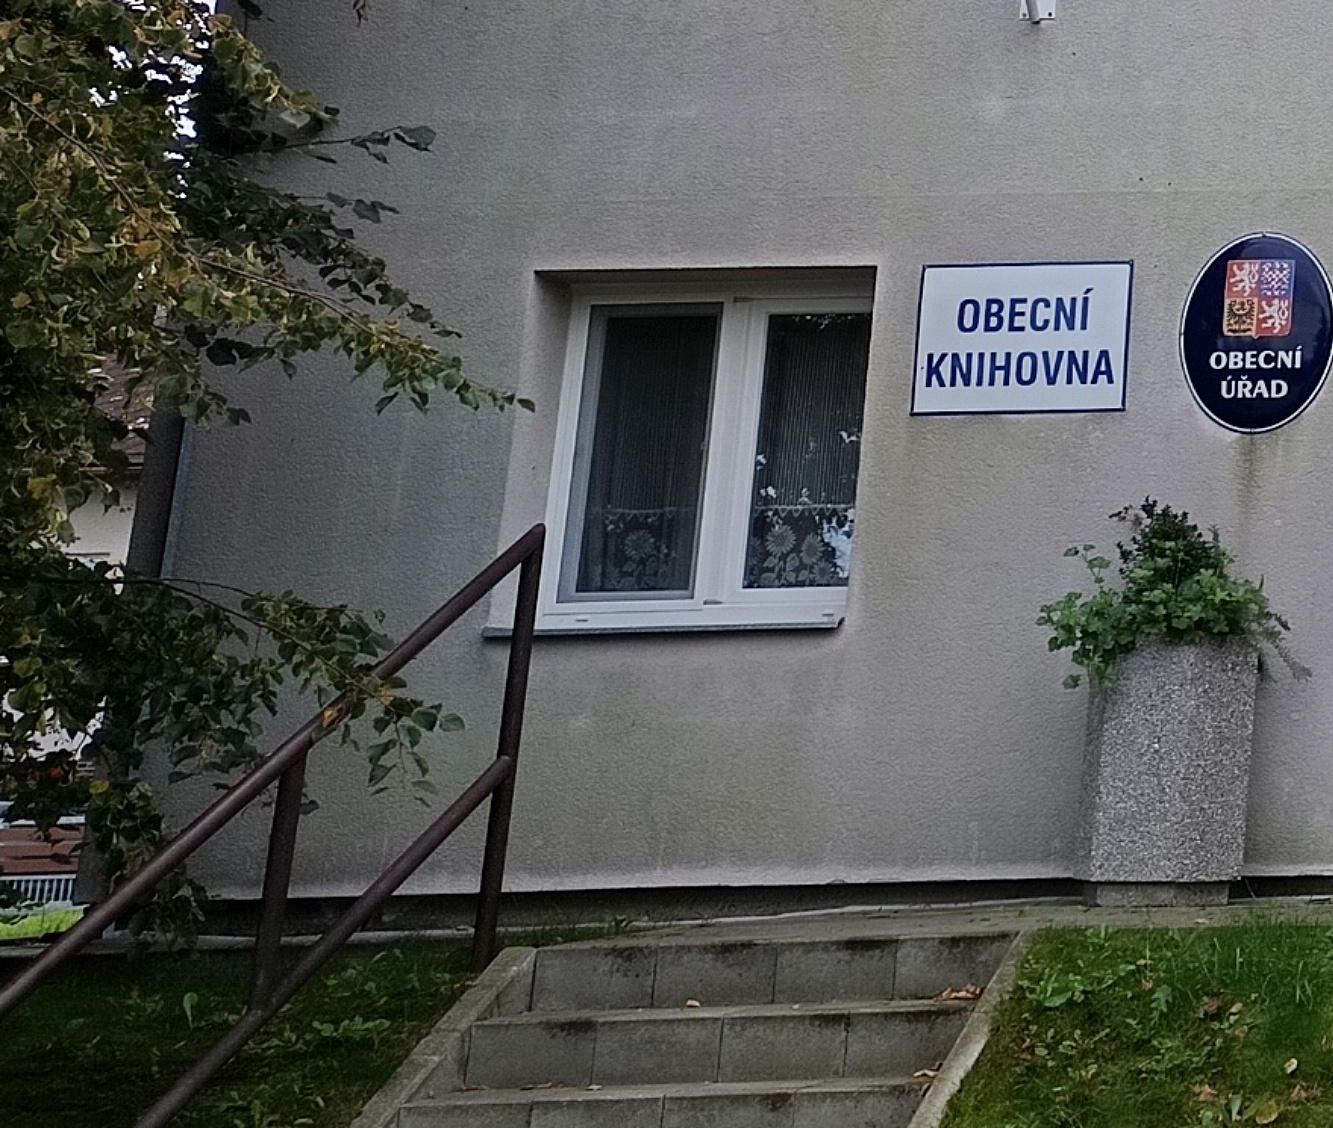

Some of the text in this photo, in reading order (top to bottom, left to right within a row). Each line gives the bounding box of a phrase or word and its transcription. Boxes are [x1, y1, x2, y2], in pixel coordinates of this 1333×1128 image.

[957, 287, 1094, 333] OBECNÍ
[925, 349, 1114, 388] KNIHOVNA
[1209, 345, 1302, 370] OBECNÍ
[1220, 375, 1289, 399] ÚŘAD
